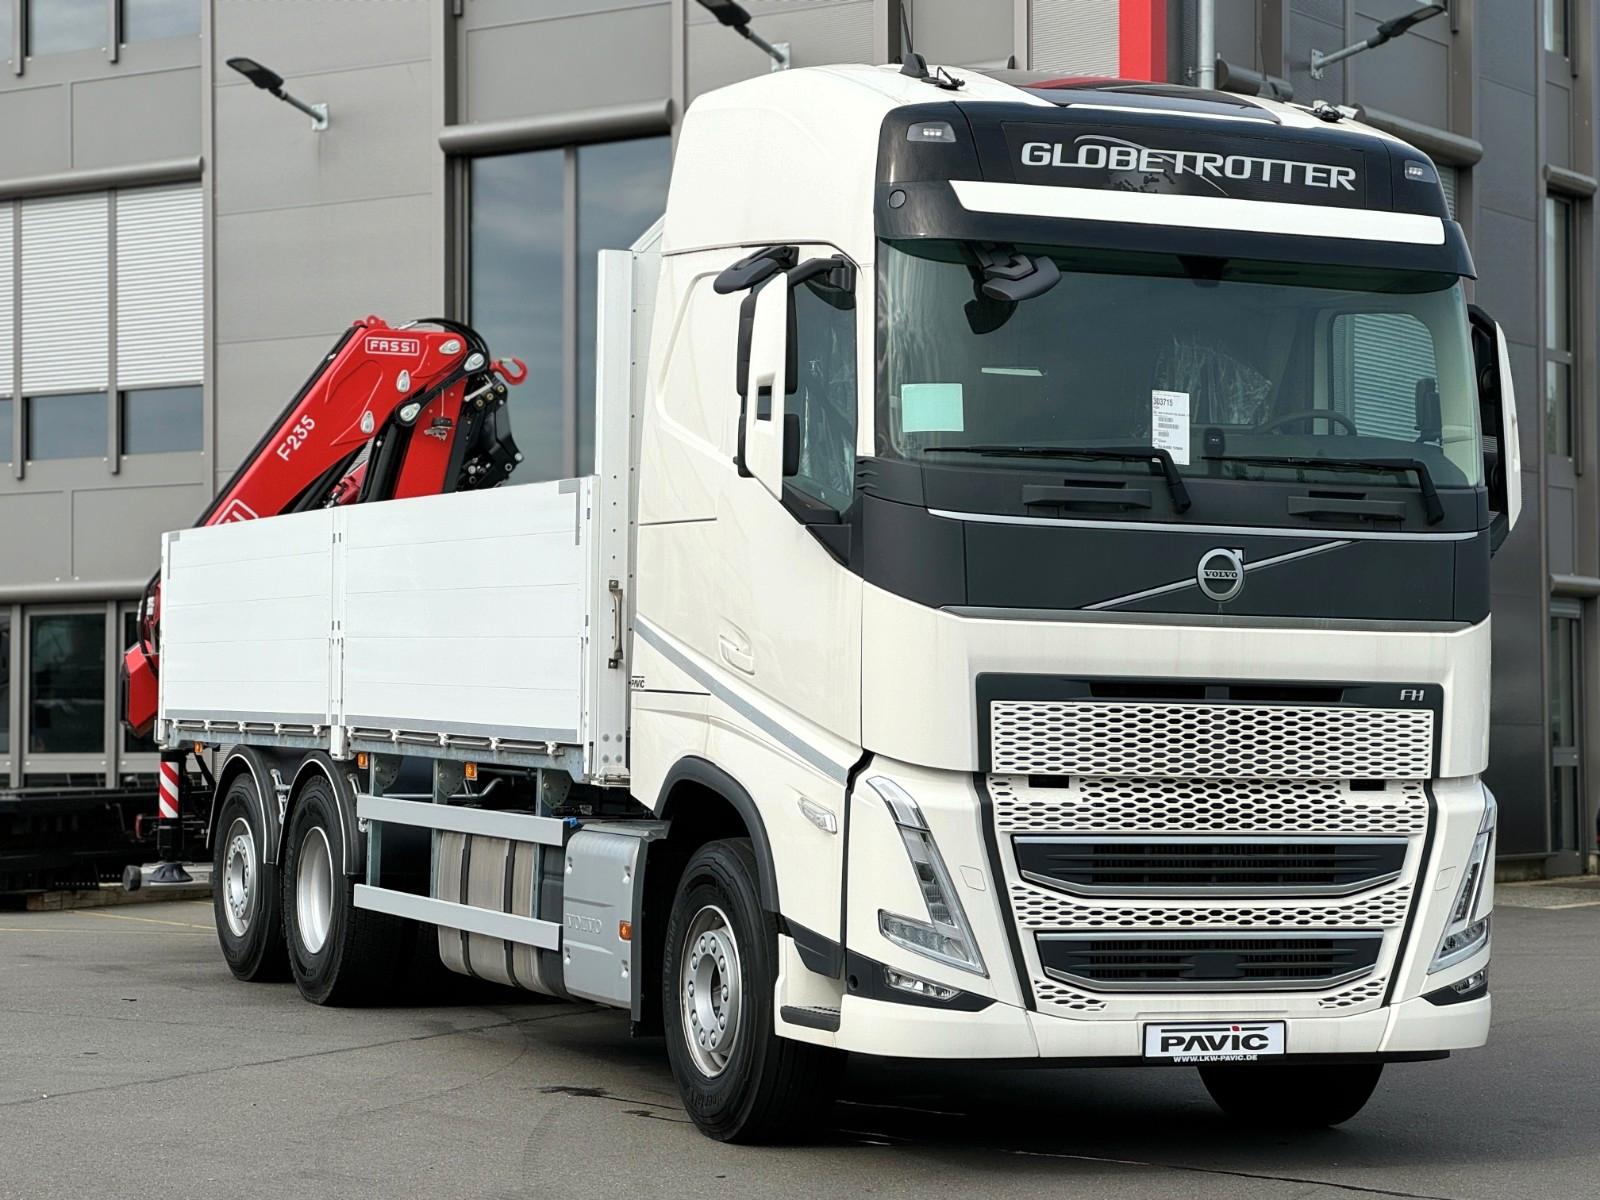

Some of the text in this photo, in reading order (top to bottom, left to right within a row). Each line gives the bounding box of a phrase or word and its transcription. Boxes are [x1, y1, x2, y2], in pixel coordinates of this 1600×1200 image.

[1021, 142, 1356, 191] GLOBETROTTER
[370, 340, 415, 353] FASSI
[276, 414, 316, 462] F235
[1204, 570, 1238, 578] VOLVO
[1400, 689, 1425, 701] FH
